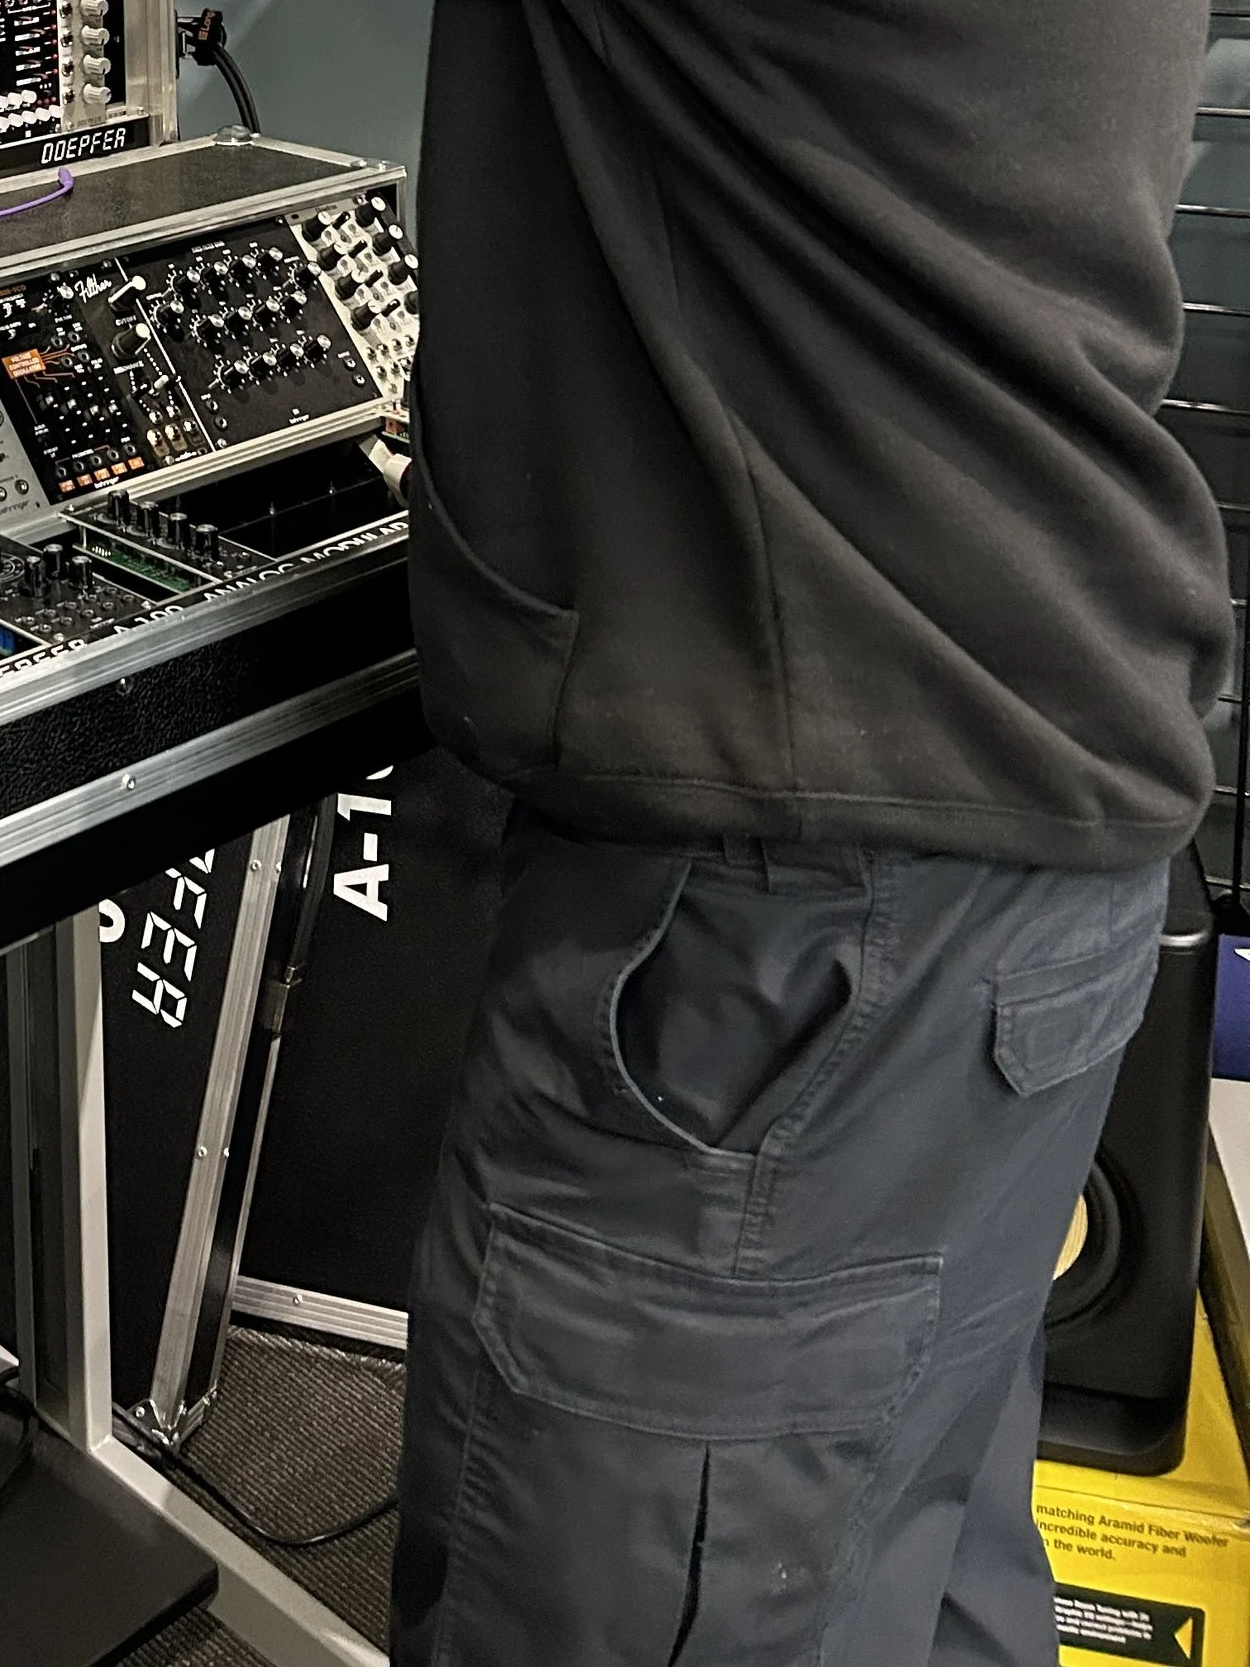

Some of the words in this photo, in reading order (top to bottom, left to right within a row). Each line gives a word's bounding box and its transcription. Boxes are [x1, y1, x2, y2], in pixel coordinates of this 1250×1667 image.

[40, 126, 127, 165] DOEPFER
[1035, 1503, 1096, 1528] matching
[1098, 1514, 1145, 1534] Aramid
[1147, 1525, 1182, 1542] Fiber
[1182, 1528, 1230, 1549] Woofer
[1035, 1518, 1097, 1541] incredible
[1100, 1533, 1160, 1555] accuracy
[1162, 1544, 1187, 1559] and
[1053, 1537, 1074, 1553] the
[1076, 1545, 1117, 1561] world.
